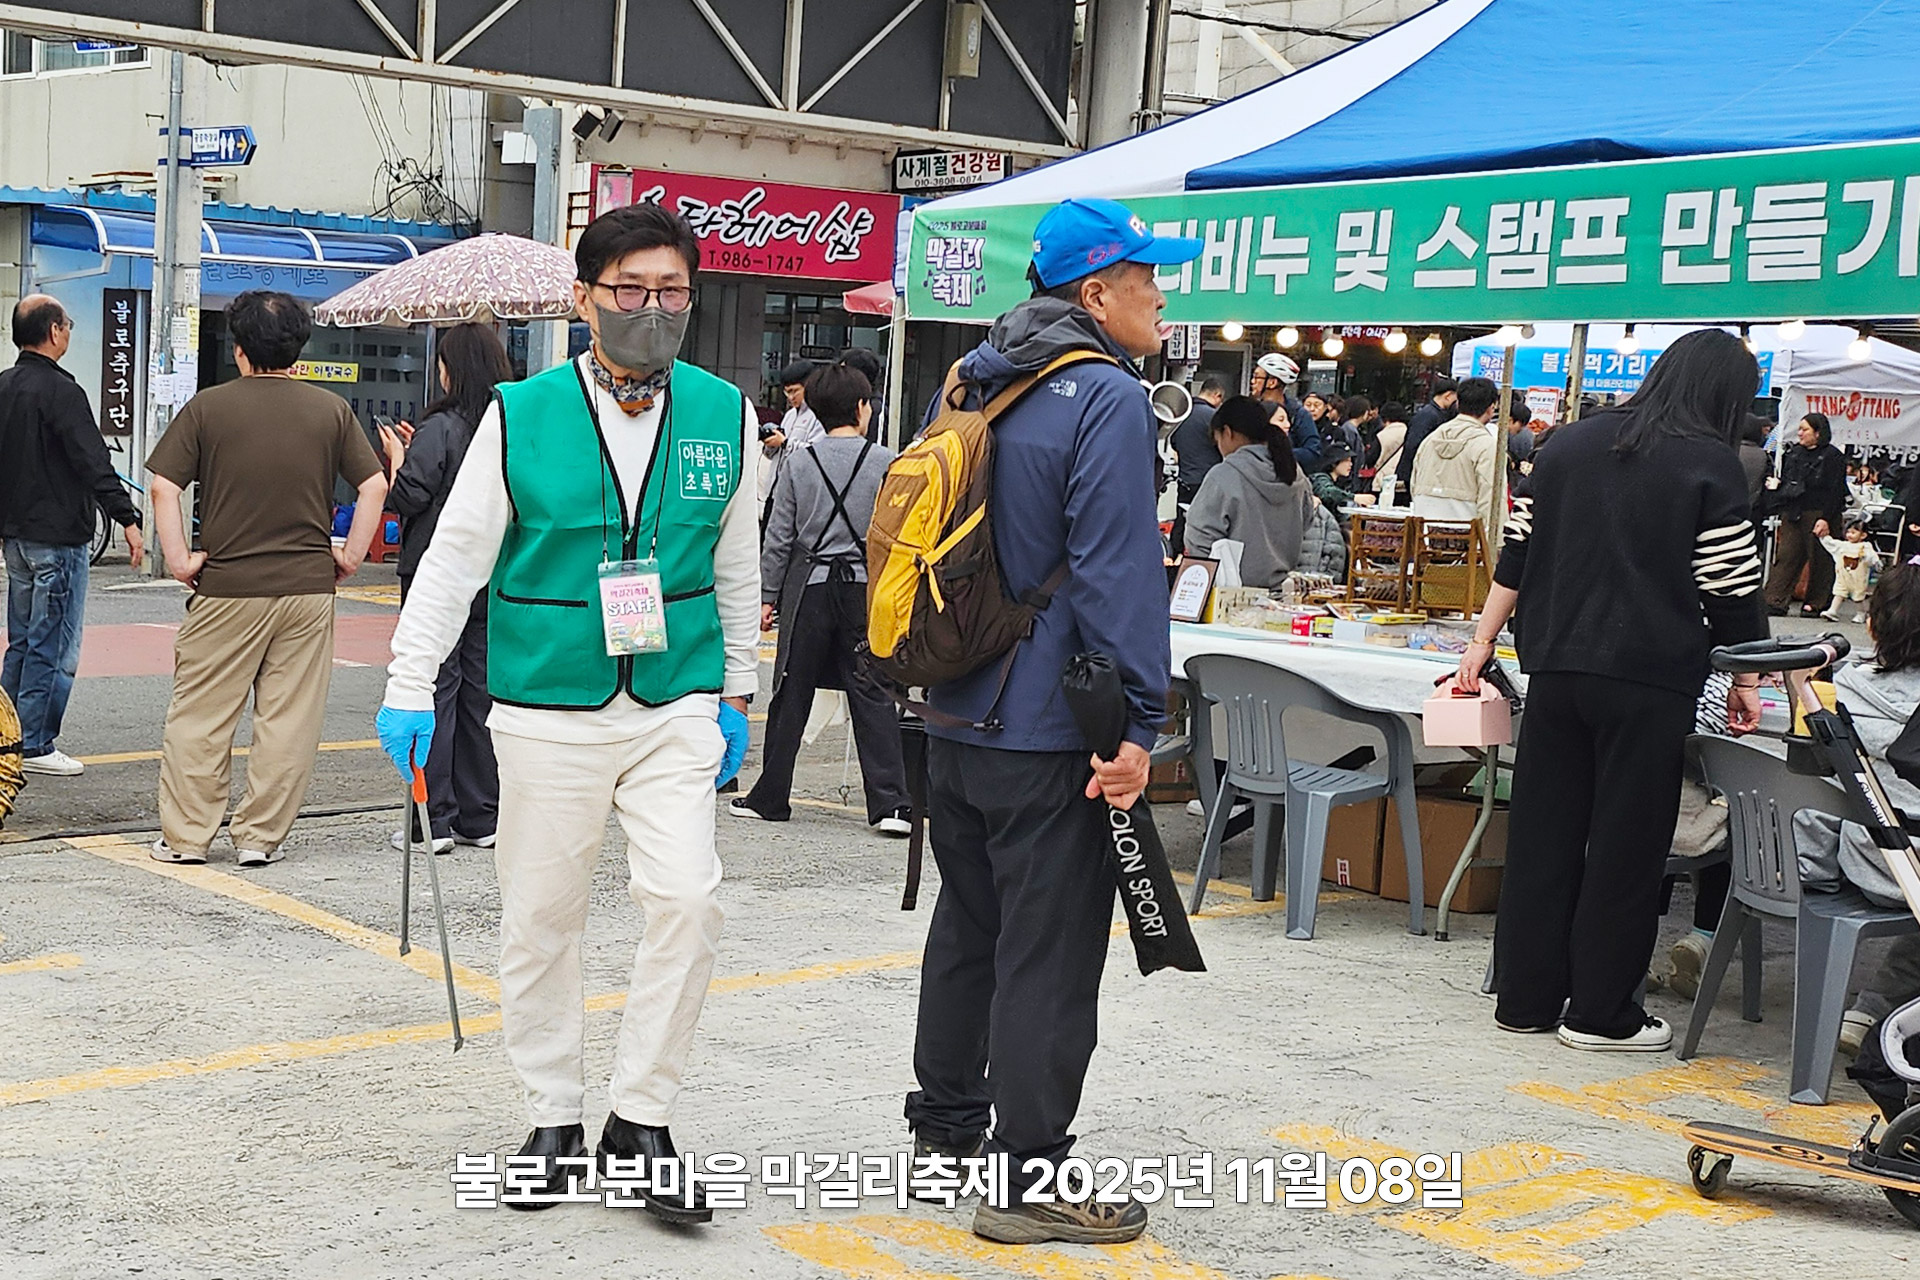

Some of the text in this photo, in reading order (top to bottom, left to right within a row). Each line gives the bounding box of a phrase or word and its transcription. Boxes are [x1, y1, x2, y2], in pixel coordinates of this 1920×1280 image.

[640, 185, 874, 263] 타헤어샵
[1334, 208, 1394, 293] 및
[1413, 196, 1631, 290] 스탬프
[1660, 175, 1920, 285] 만들기
[926, 236, 985, 270] 막걸리
[932, 272, 972, 306] 축제
[107, 299, 132, 429] 불로축구단
[1806, 395, 1901, 419] TTANG TTANG
[682, 443, 727, 468] 아름다운
[684, 471, 728, 496] 초록단
[607, 597, 656, 617] STAFF
[1109, 804, 1168, 938] OLON SPORT
